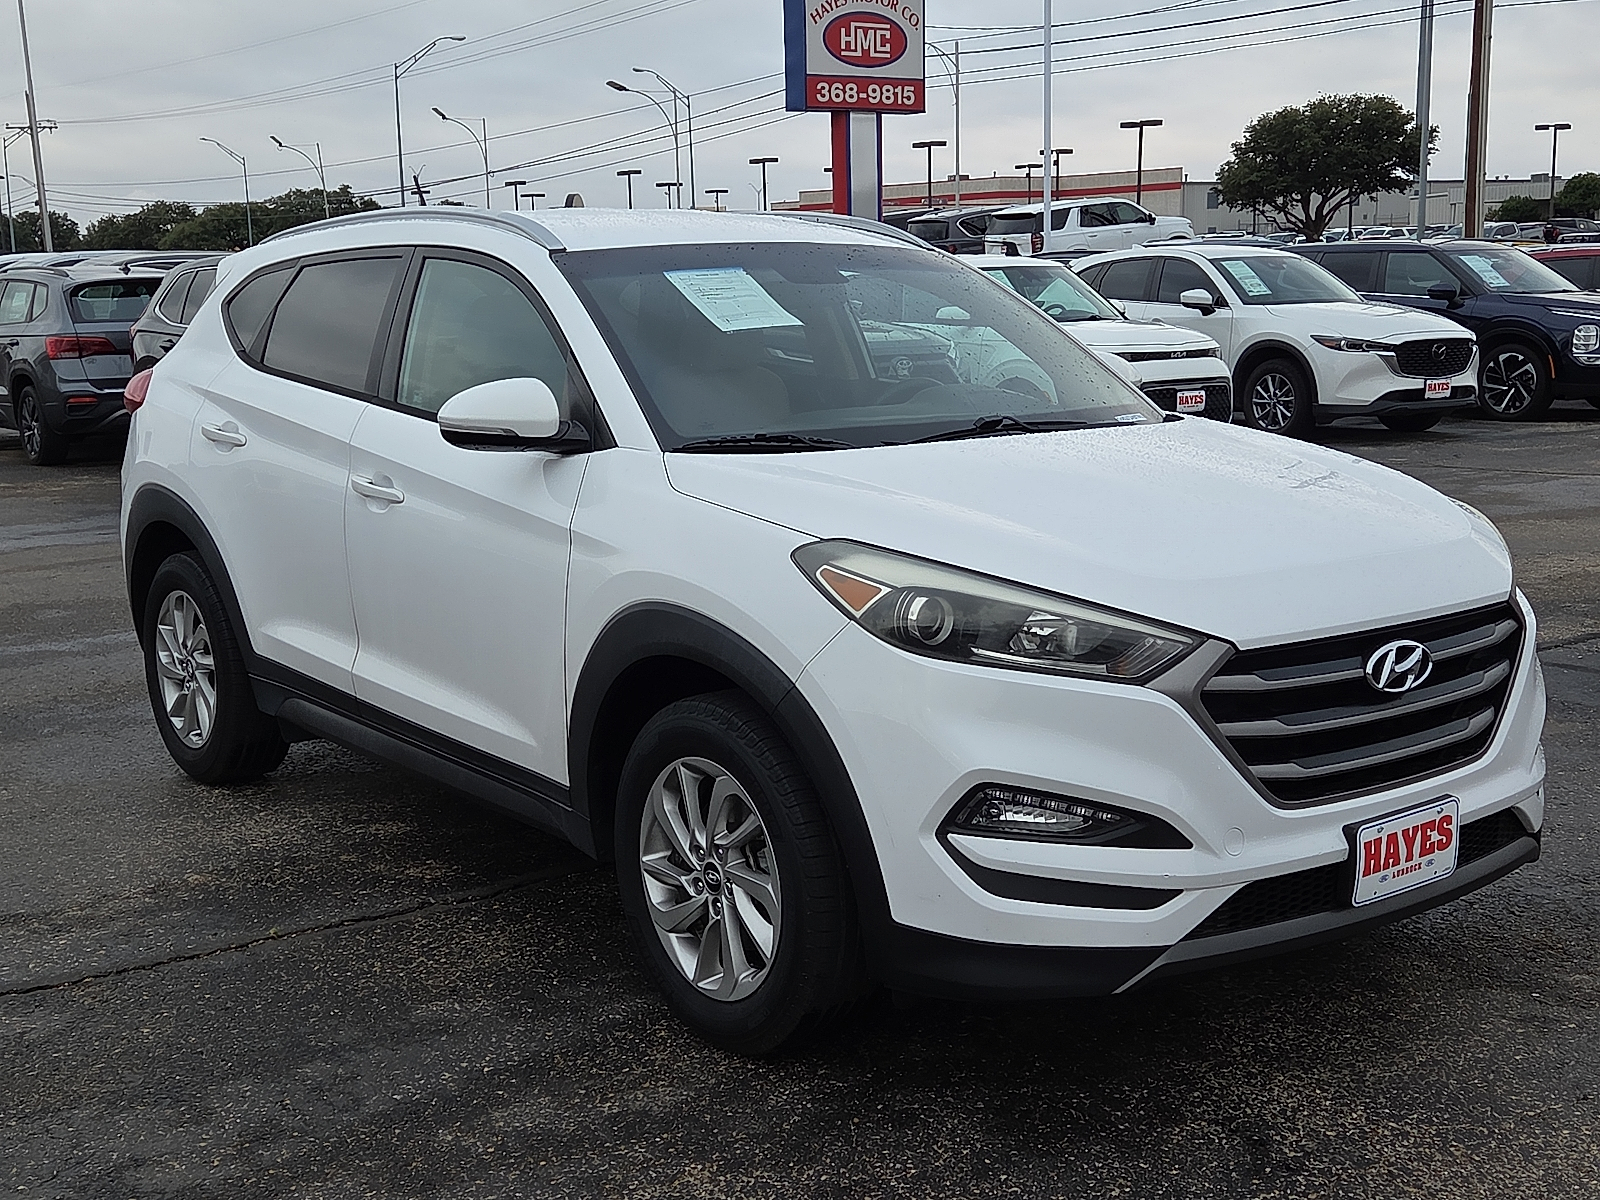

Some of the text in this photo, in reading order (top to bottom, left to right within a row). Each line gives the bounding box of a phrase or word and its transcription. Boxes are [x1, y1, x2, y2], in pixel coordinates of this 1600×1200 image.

[901, 6, 920, 31] CO.
[840, 21, 891, 58] HMC
[816, 82, 915, 105] 368-9815
[1427, 382, 1450, 392] HAYES
[1178, 394, 1204, 406] HAYES
[1362, 815, 1454, 878] HAYES
